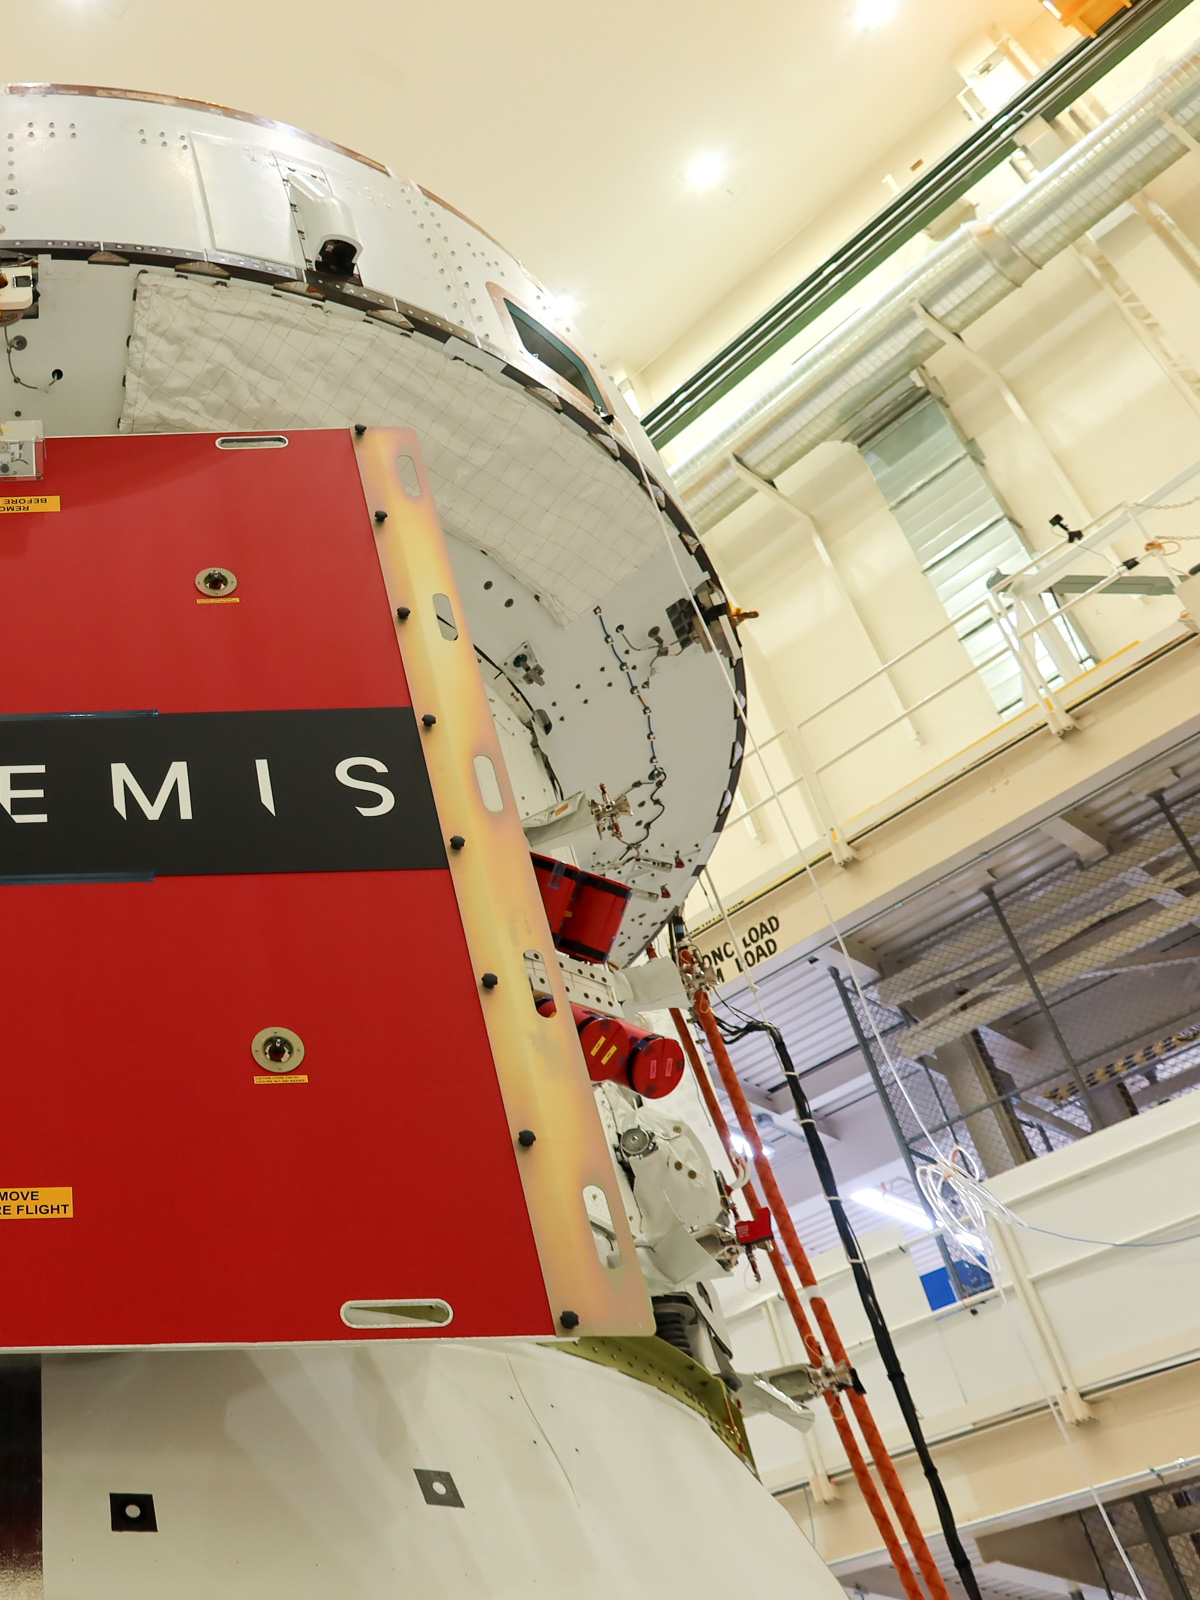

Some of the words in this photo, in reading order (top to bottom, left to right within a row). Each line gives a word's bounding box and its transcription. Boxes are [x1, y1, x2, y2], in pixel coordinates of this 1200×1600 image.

[4, 497, 47, 505] BEFORE
[742, 916, 780, 948] LOAD
[735, 938, 777, 972] LOAD
[16, 1204, 69, 1215] FLIGHT
